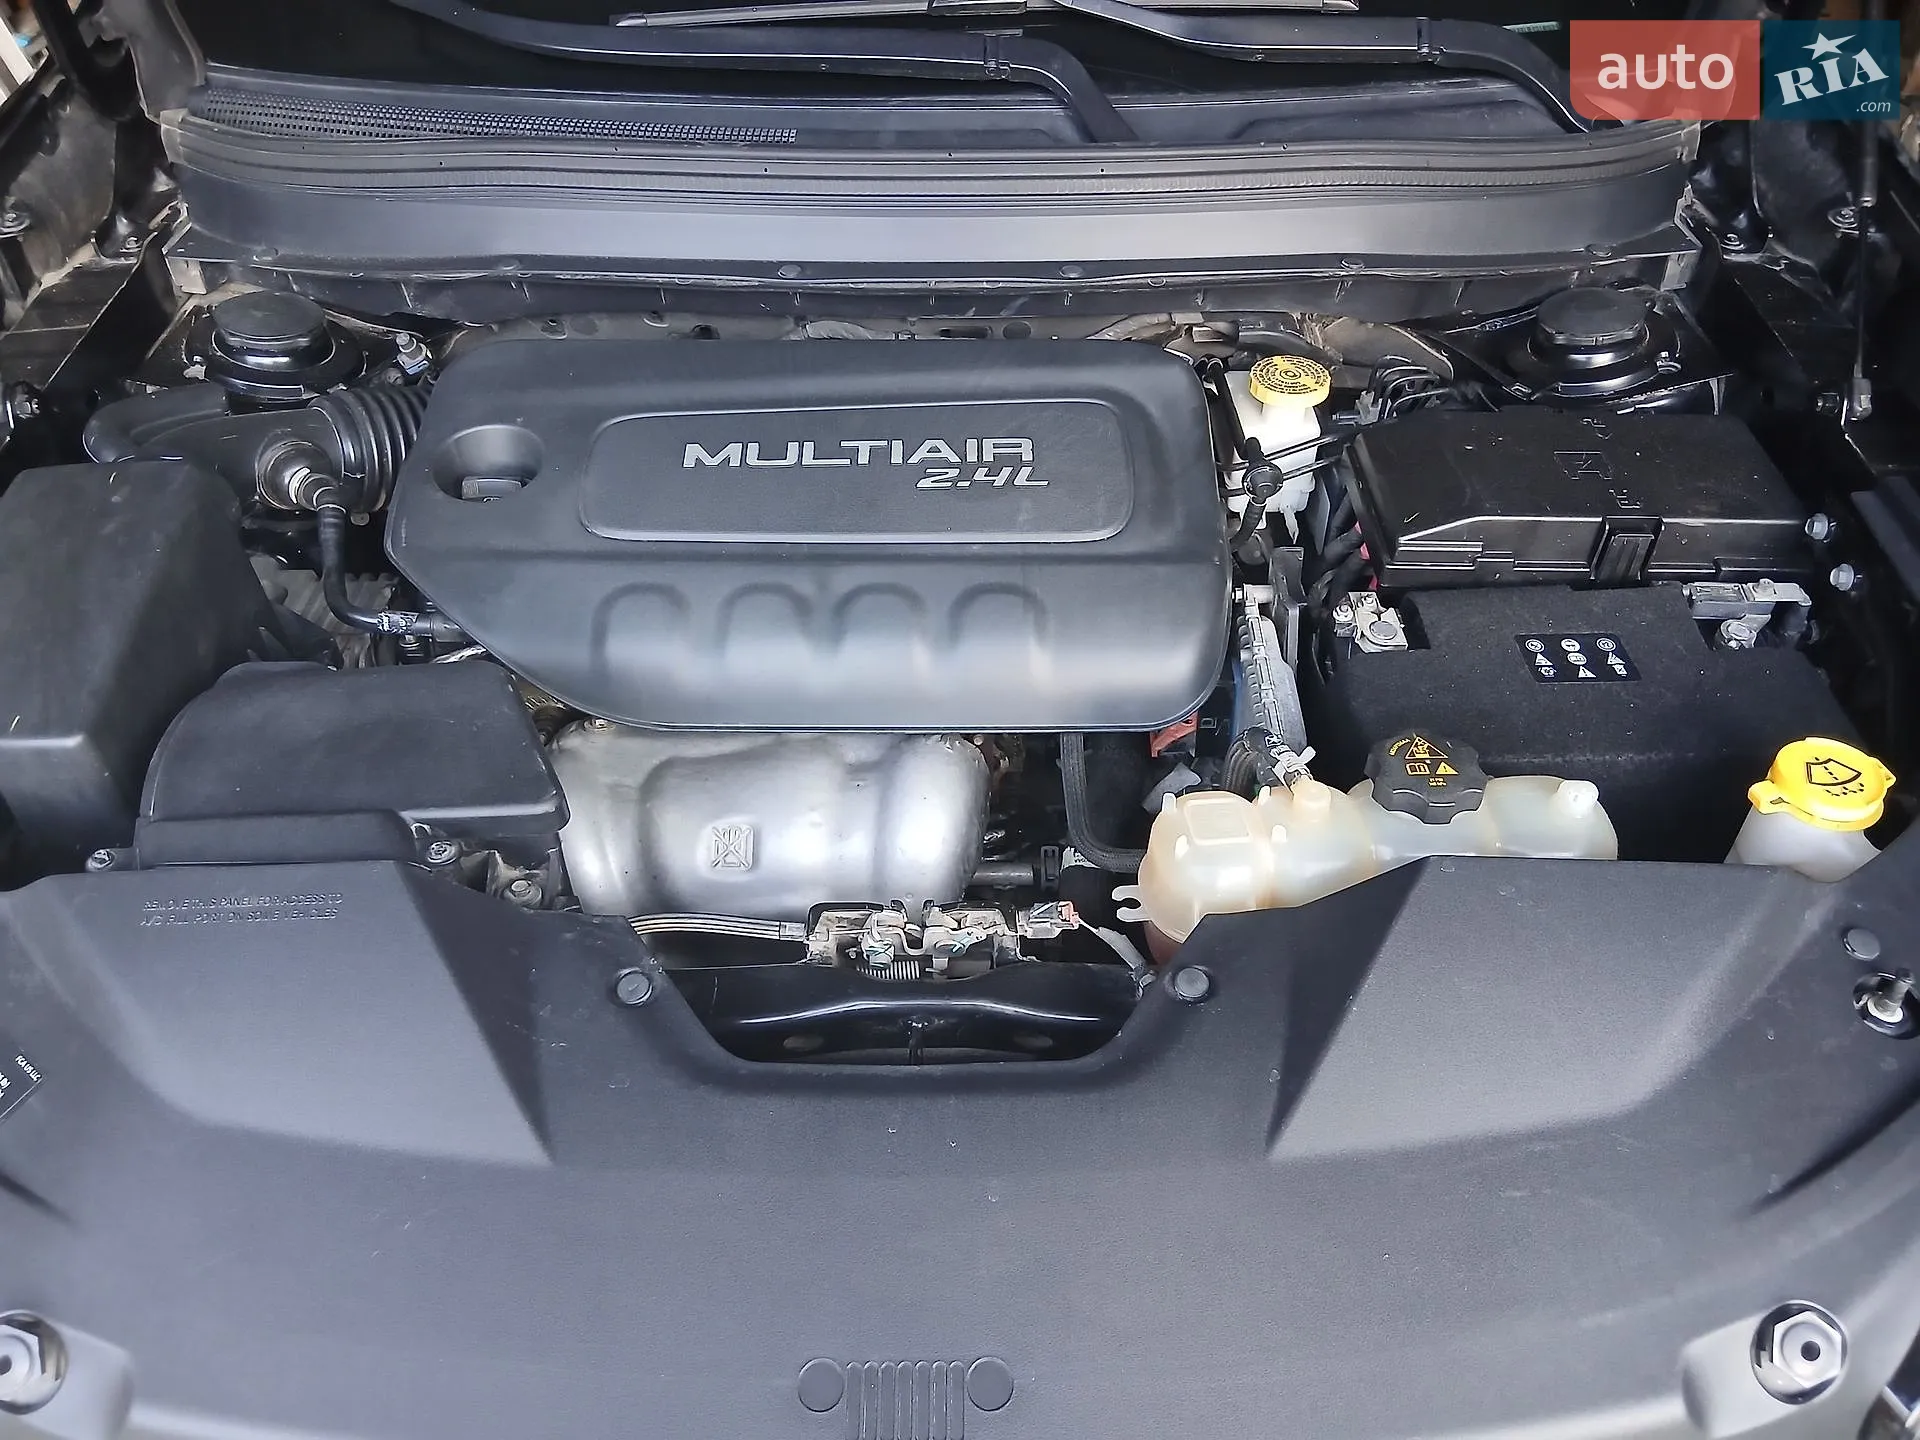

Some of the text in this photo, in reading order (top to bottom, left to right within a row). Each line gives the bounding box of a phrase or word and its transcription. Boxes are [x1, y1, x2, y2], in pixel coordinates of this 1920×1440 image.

[683, 437, 1034, 468] MULTIAIR
[915, 466, 1049, 490] 2.4L
[219, 896, 253, 908] PANEL
[15, 1055, 28, 1068] FCA
[23, 1063, 34, 1074] US
